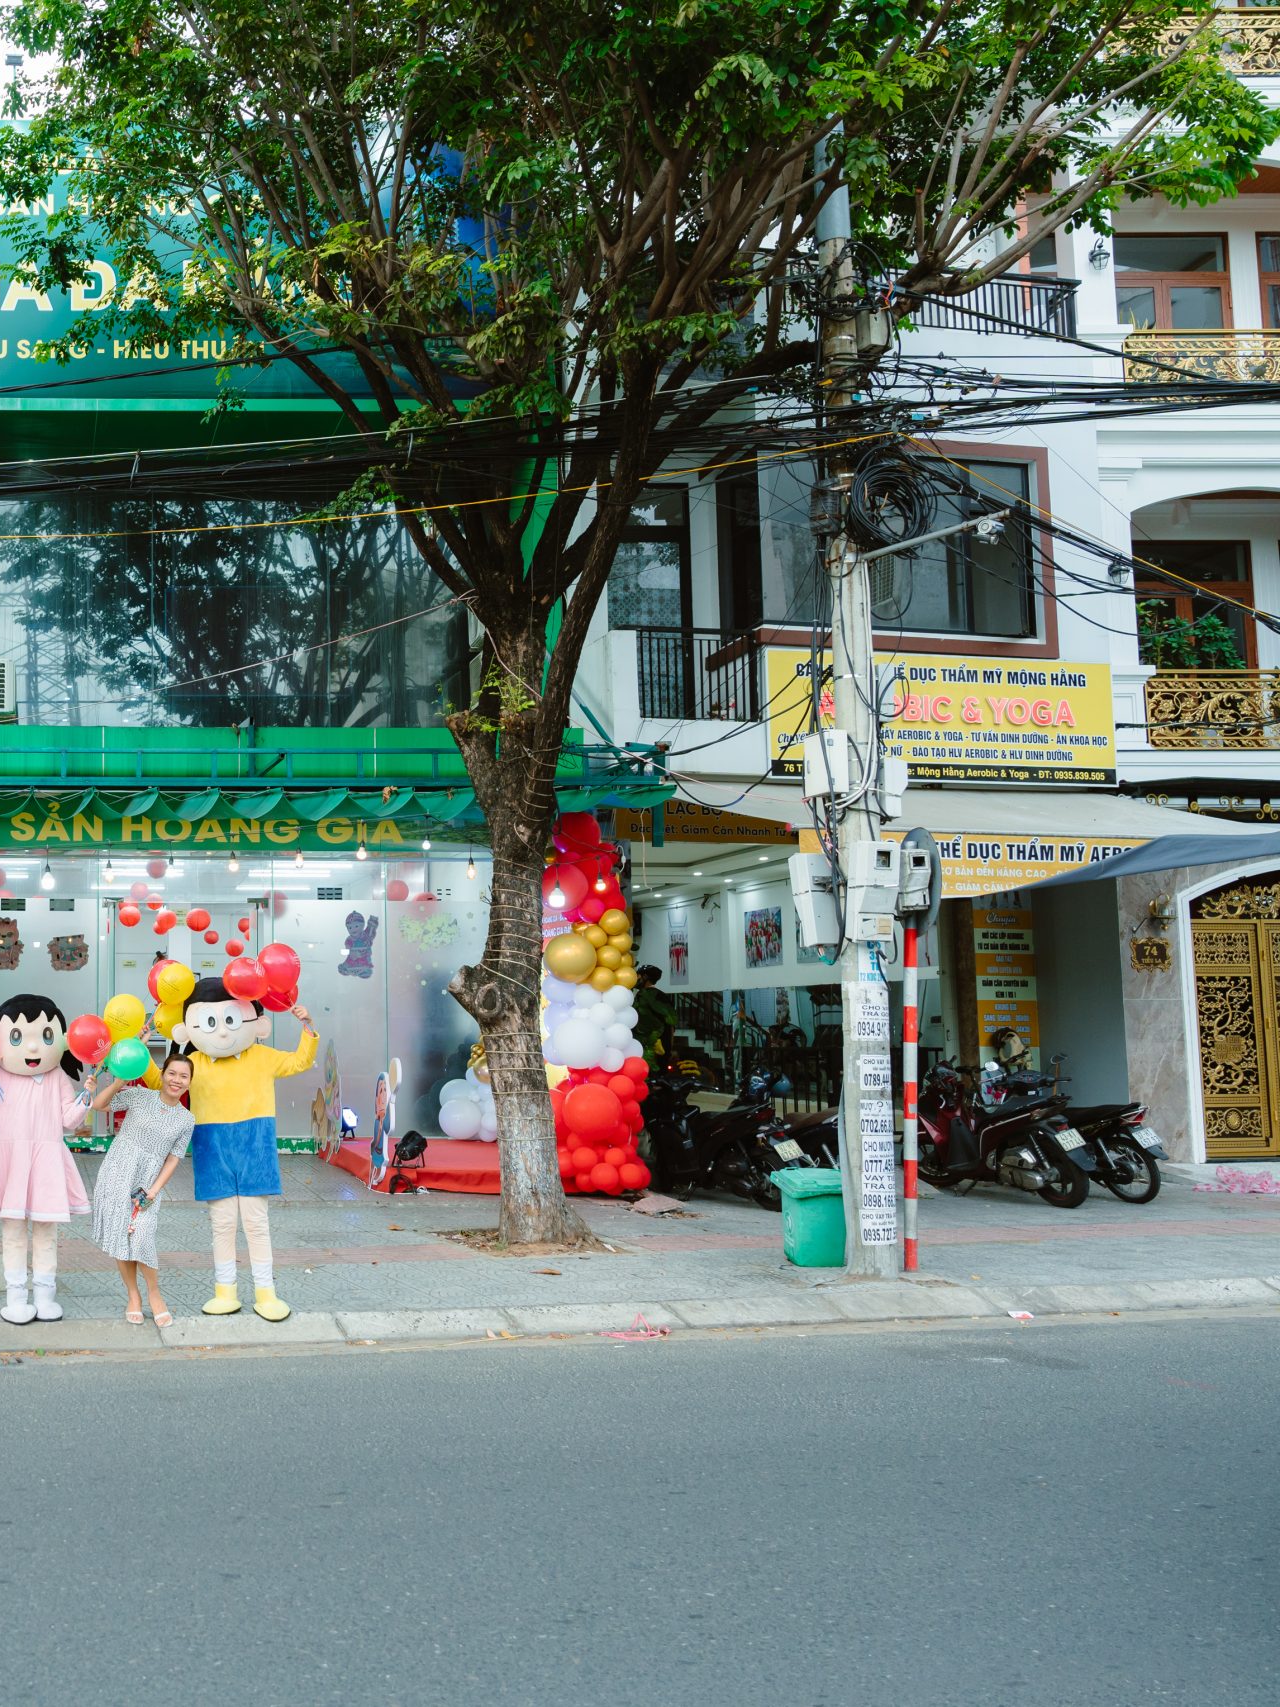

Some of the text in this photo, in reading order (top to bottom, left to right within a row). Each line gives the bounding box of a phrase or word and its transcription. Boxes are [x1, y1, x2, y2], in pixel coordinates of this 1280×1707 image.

[910, 667, 937, 685] DỤC
[941, 663, 978, 683] THẨM
[982, 667, 1003, 684] MỸ
[1007, 668, 1047, 688] MỘNG
[1050, 668, 1087, 687] HẰNG
[960, 696, 983, 725] &
[987, 697, 1076, 727] YOGA
[897, 730, 932, 741] AEROBIC
[934, 731, 941, 741] &
[942, 731, 963, 742] YOGA
[971, 730, 982, 742] TƯ
[1001, 732, 1021, 743] DINH
[1069, 735, 1090, 746] KHOA
[1092, 736, 1108, 748] HỌC
[930, 747, 947, 760] TẠO
[948, 748, 963, 758] HLV
[964, 749, 999, 760] AEROBIC
[1001, 749, 1007, 759] &
[1009, 750, 1023, 760] HLV
[1025, 750, 1045, 761] DINH
[783, 763, 795, 773] 76
[917, 767, 941, 779] Mộng
[942, 767, 966, 780] Hằng
[966, 768, 998, 778] Aerobic
[1000, 769, 1008, 778] &
[1009, 769, 1029, 780] Yoga
[1038, 770, 1053, 779] ĐT:
[1054, 771, 1105, 781] 0935.839.505
[317, 816, 404, 845] GIA
[736, 825, 770, 836] Nhanh
[967, 842, 1002, 863] DỤC
[1006, 837, 1055, 862] THẨM
[1060, 842, 1086, 862] MỸ
[1025, 869, 1047, 878] CAO
[1143, 945, 1158, 956] 74
[864, 1141, 878, 1152] CHO
